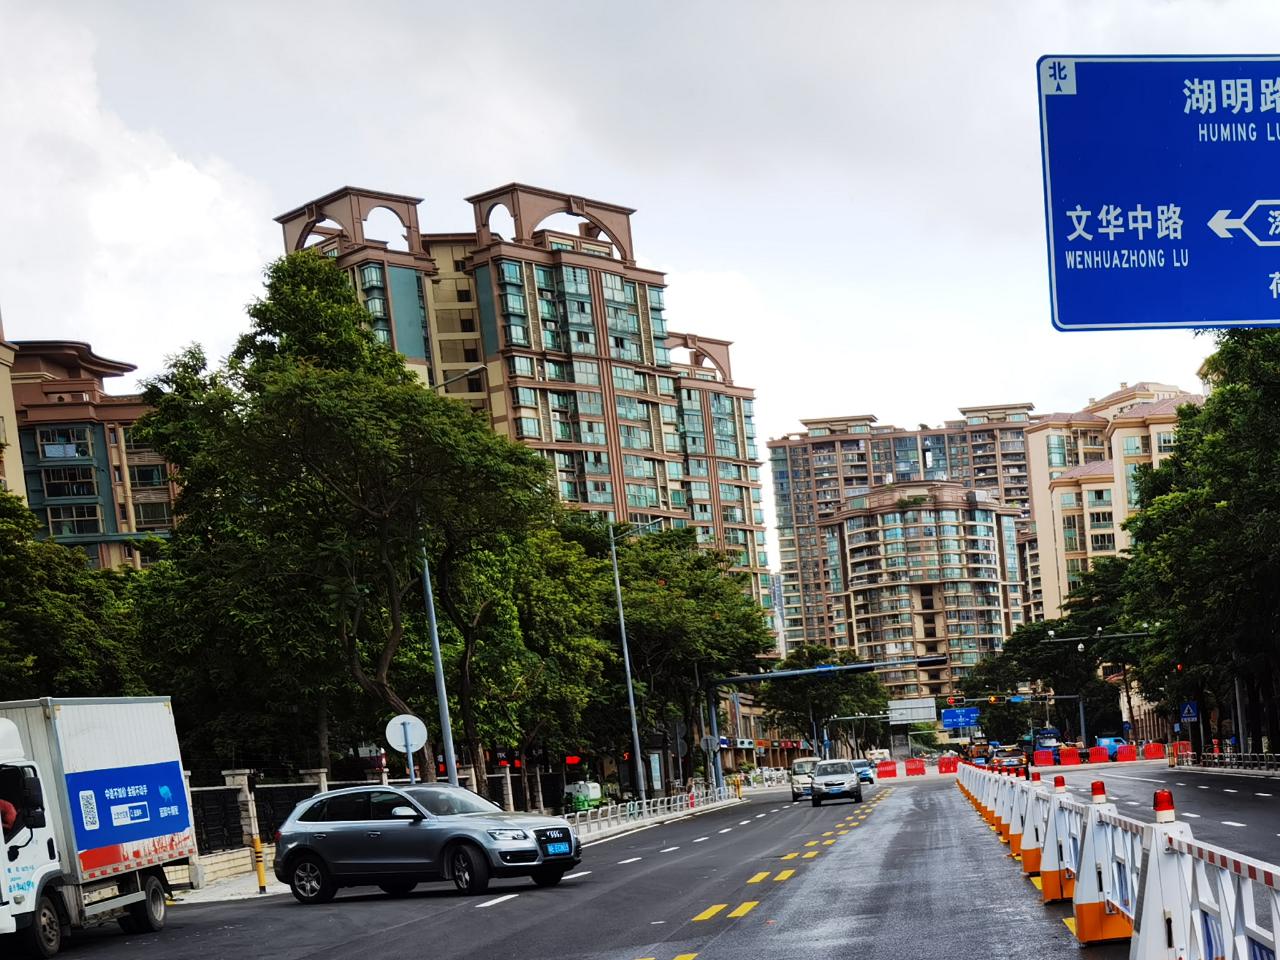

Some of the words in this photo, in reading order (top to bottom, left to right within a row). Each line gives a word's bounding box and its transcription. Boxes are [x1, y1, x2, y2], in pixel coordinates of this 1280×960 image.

[1047, 60, 1068, 84] 北
[1198, 123, 1257, 142] HUMING
[1066, 203, 1184, 241] 文华中路
[1065, 249, 1165, 269] WENHUAZHONG
[1173, 249, 1189, 267] LU
